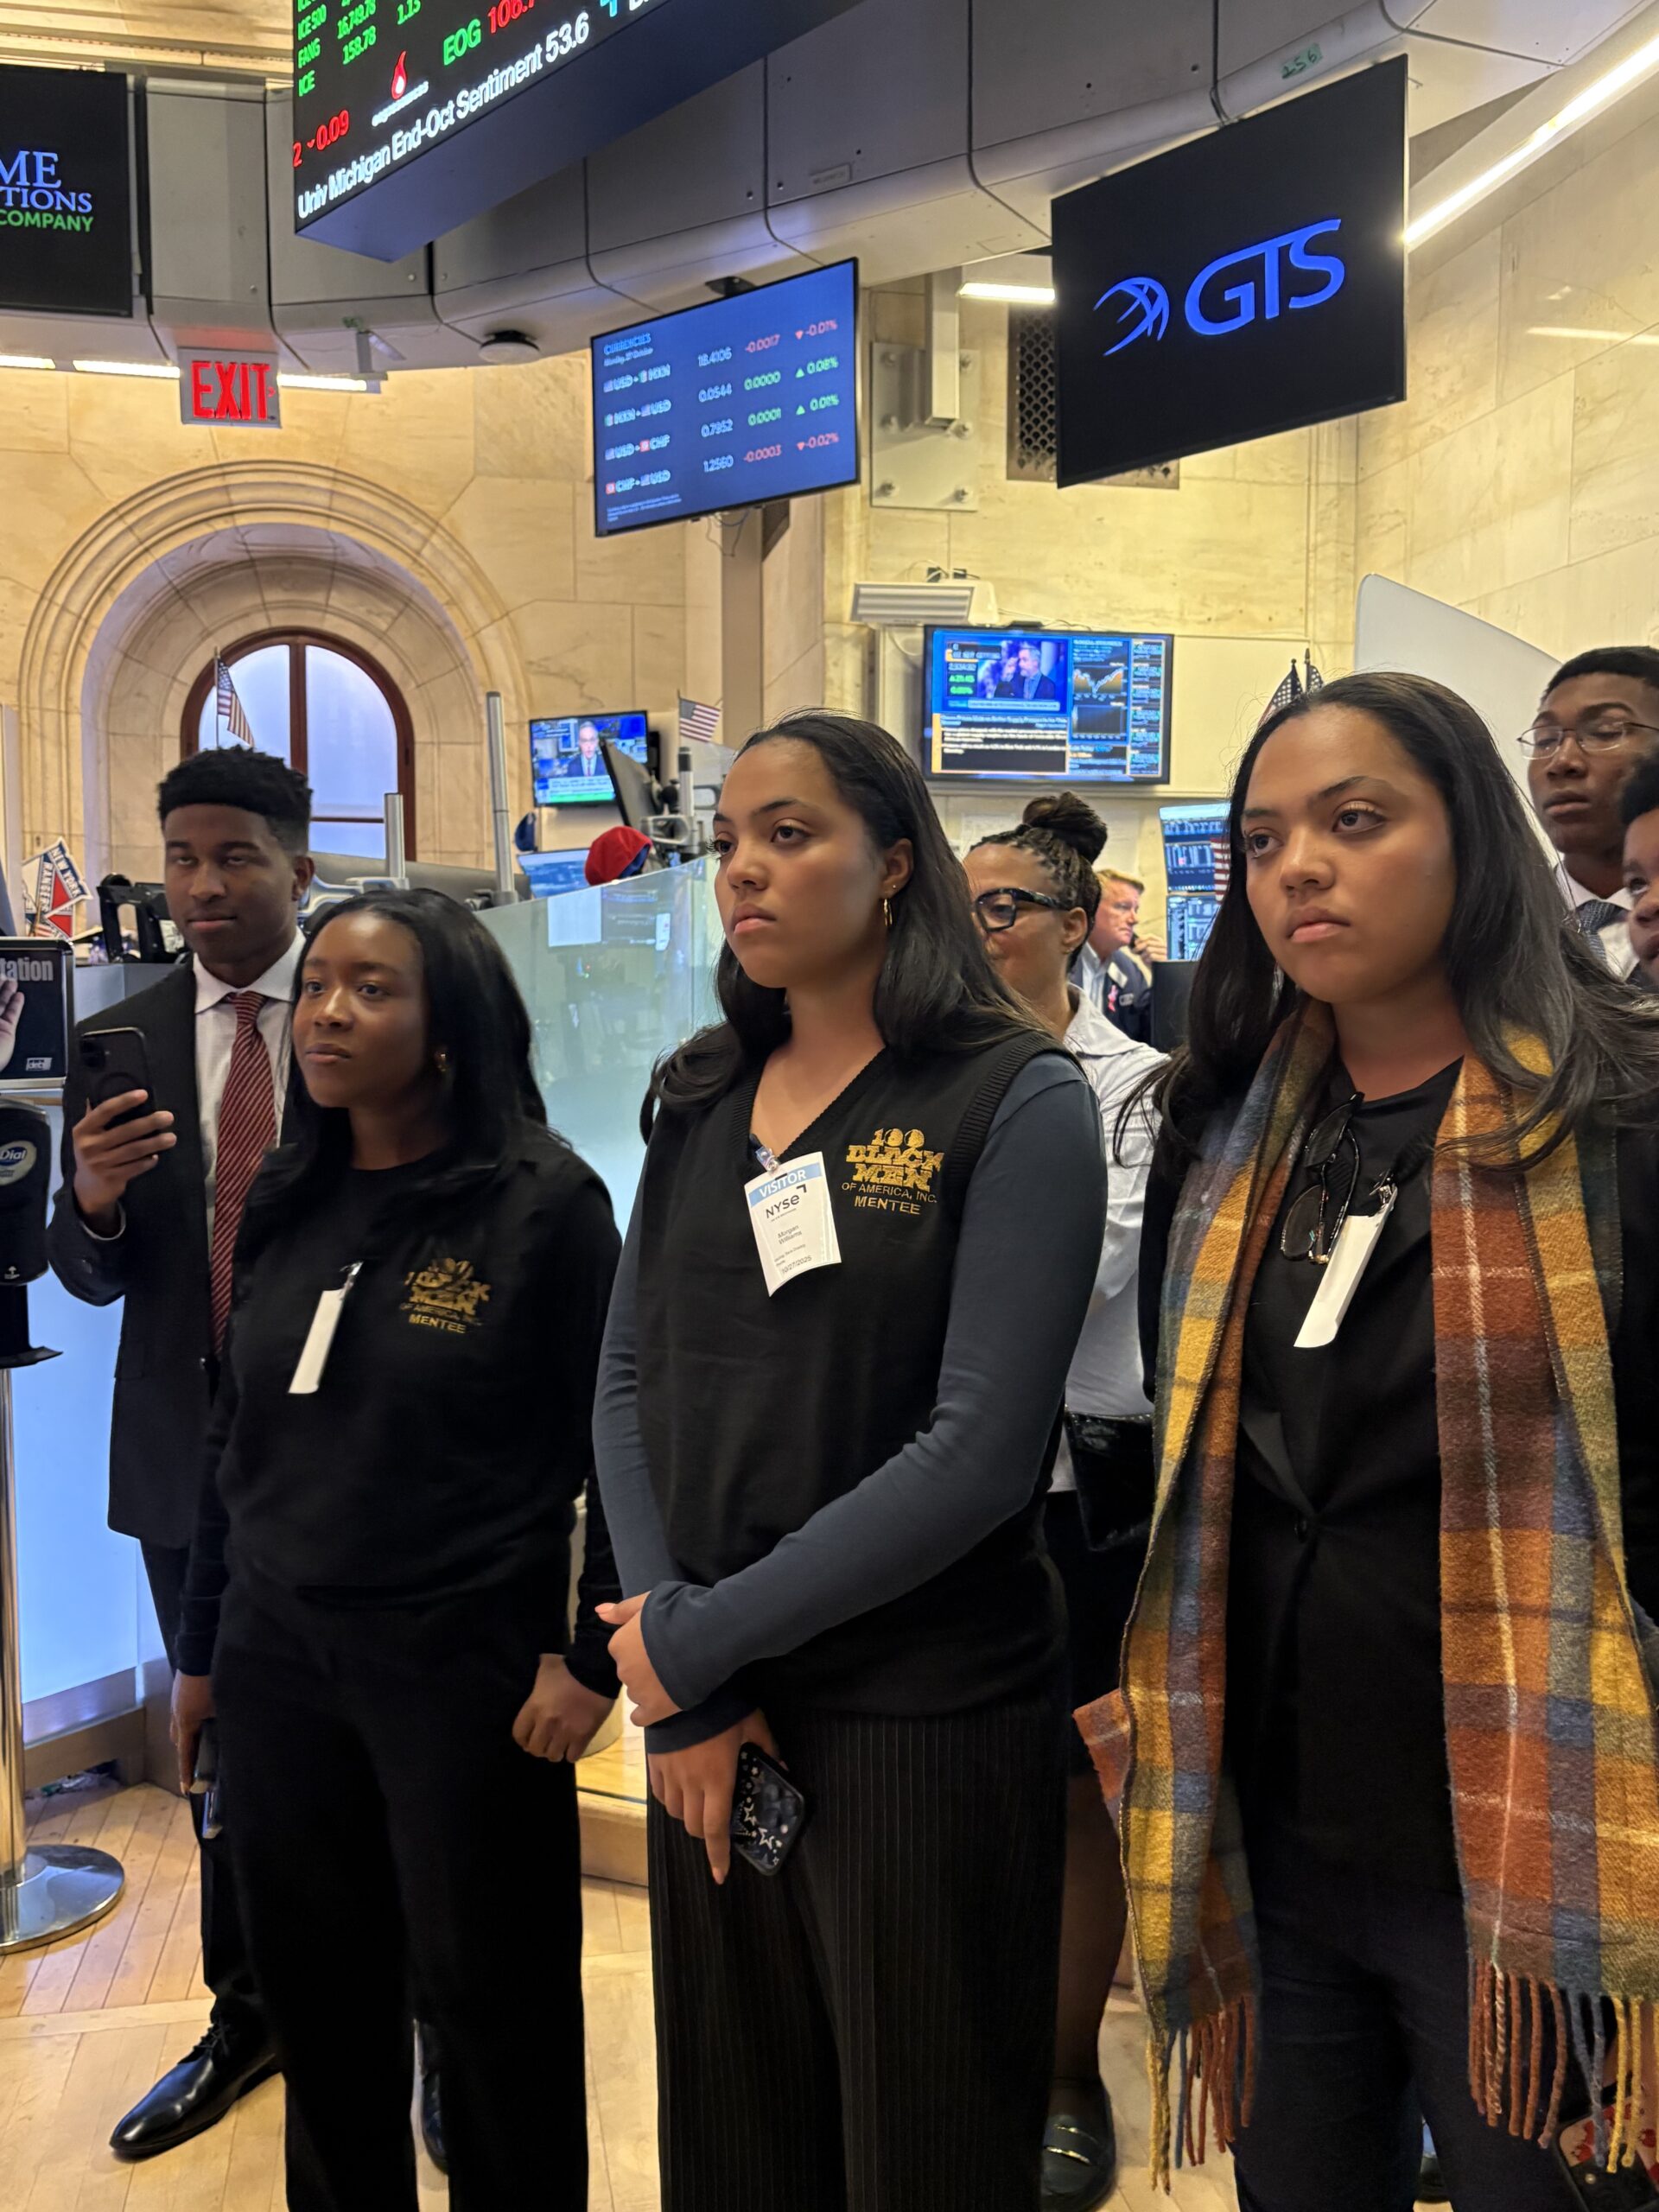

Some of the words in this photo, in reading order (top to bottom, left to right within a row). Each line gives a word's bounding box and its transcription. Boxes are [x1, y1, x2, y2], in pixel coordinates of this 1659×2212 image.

[297, 16, 312, 41] ICE
[311, 4, 327, 30] 500
[297, 38, 321, 69] FANG
[443, 19, 481, 66] EOG
[298, 70, 315, 97] ICE
[342, 25, 376, 65] 158.78
[298, 183, 327, 219] Univ
[327, 145, 391, 200] Michigan
[391, 100, 455, 161] End-Oct
[456, 43, 543, 119] Sentiment
[545, 12, 589, 63] 53.6
[316, 110, 349, 150] 0.09
[0, 150, 61, 188] ME
[0, 186, 92, 213] TIONS
[1185, 219, 1345, 335] GTS
[192, 360, 270, 421] EXIT
[744, 371, 781, 391] 0.0000
[871, 1128, 925, 1147] 100
[0, 1149, 27, 1160] Dial
[846, 1145, 944, 1172] BLACK
[759, 1169, 806, 1198] VISITOR
[852, 1163, 932, 1192] MEN
[842, 1182, 857, 1191] OF
[858, 1184, 912, 1200] AMERICA,
[916, 1191, 938, 1204] INC.
[854, 1196, 921, 1215] MENTEE
[409, 1313, 467, 1333] MENTEE
